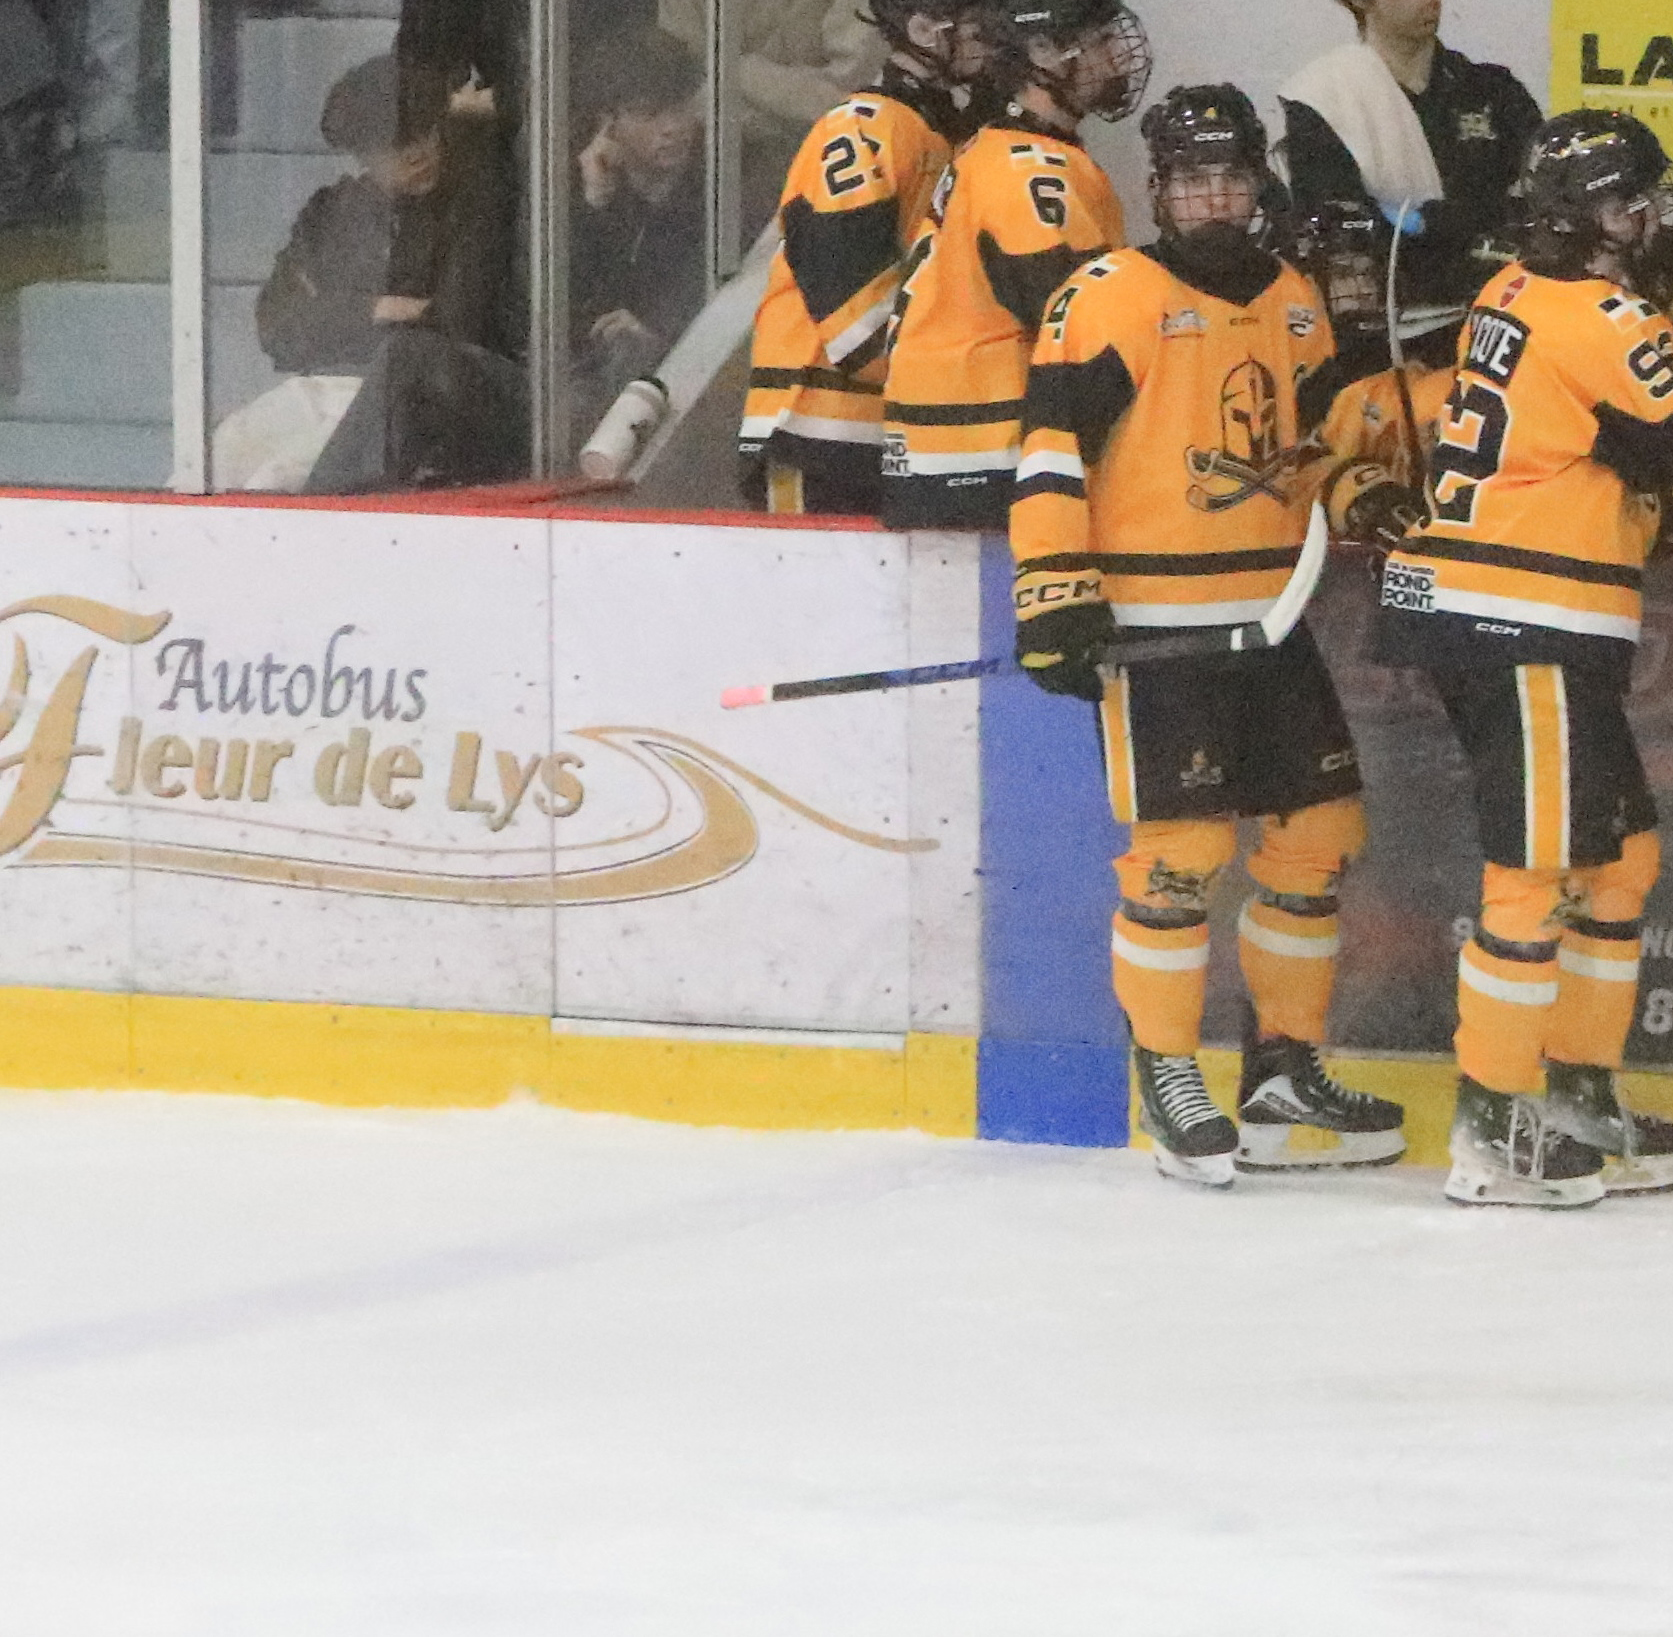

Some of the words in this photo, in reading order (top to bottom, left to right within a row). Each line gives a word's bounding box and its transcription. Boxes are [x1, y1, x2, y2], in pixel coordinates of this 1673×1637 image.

[1193, 131, 1235, 143] CCM
[1585, 171, 1622, 191] CCM
[1027, 175, 1068, 229] 6
[1042, 286, 1081, 345] 4
[946, 476, 988, 488] CCM
[1014, 578, 1101, 610] CCM
[1382, 589, 1435, 611] POINT
[1474, 621, 1522, 637] CCM
[156, 624, 428, 723] Autobus
[313, 726, 423, 810] de
[445, 729, 586, 833] Lys
